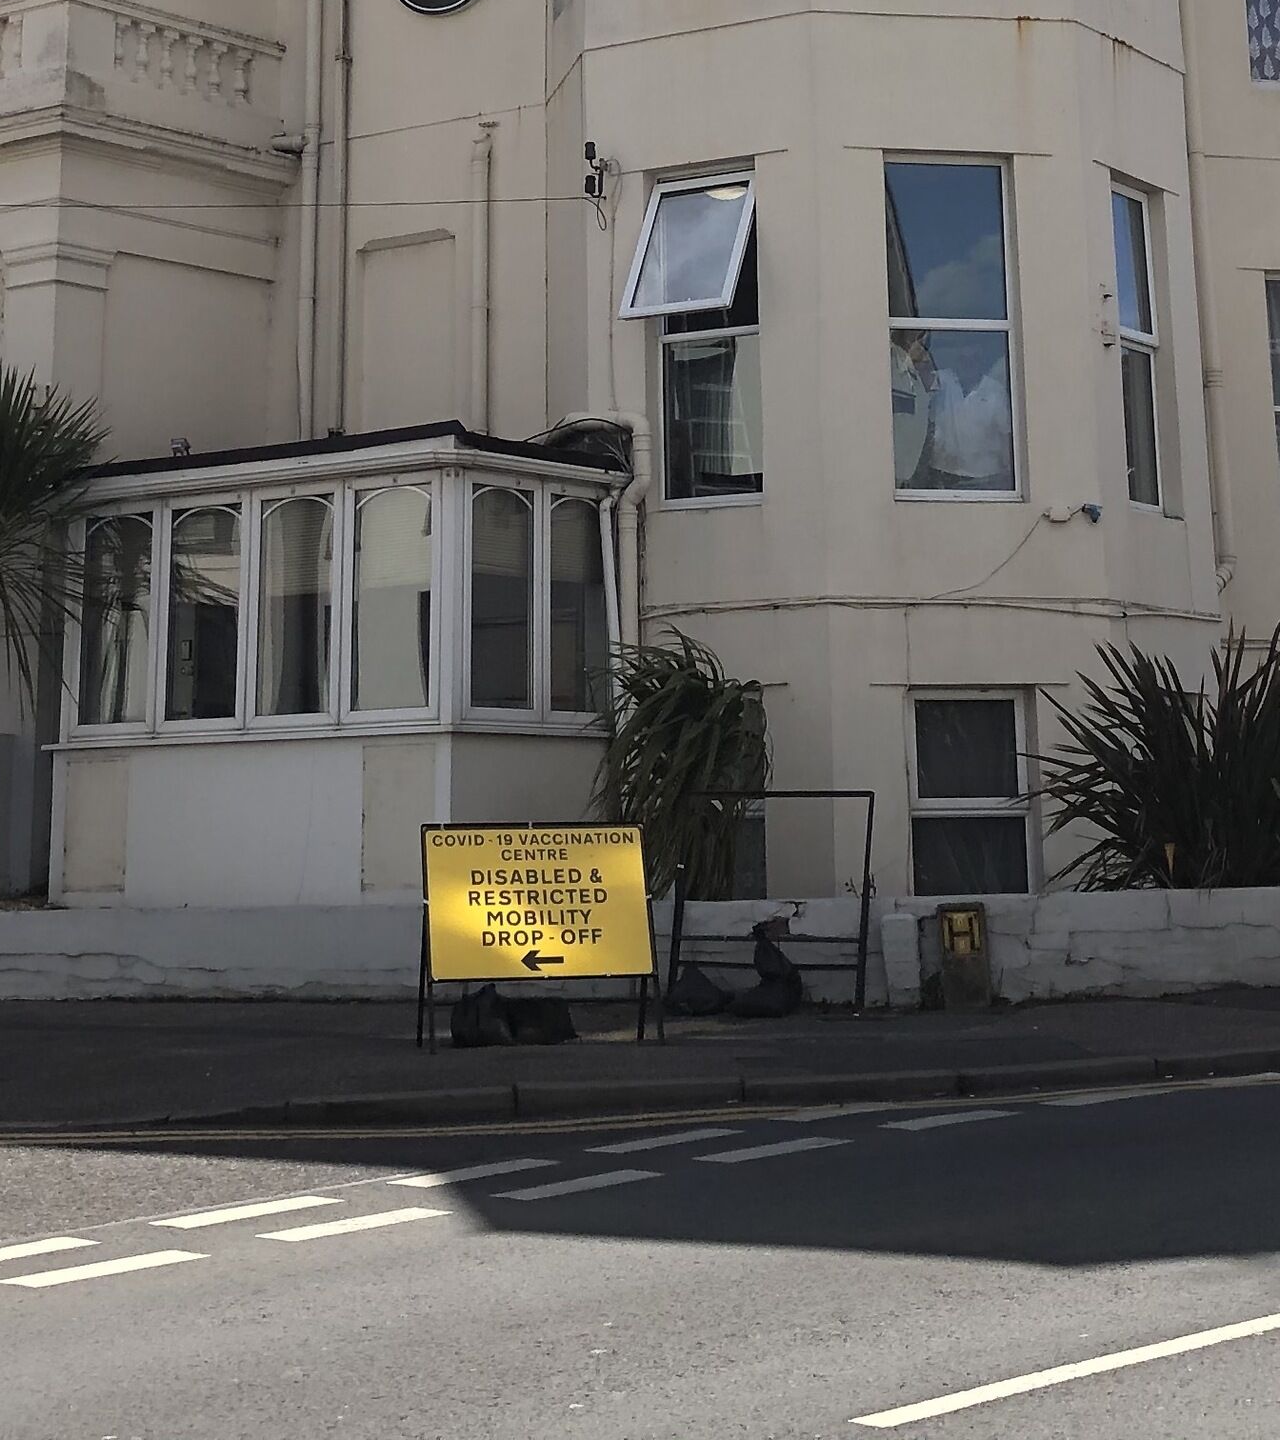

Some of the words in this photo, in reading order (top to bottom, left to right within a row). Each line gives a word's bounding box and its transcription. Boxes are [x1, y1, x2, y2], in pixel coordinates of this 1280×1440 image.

[519, 832, 634, 846] VACCINATION
[501, 848, 568, 861] CENTRE
[471, 868, 582, 886] DISABLED
[589, 868, 603, 884] &
[468, 888, 608, 906] RESTRICTED
[487, 909, 592, 926] MOBILITY
[947, 917, 976, 952] H
